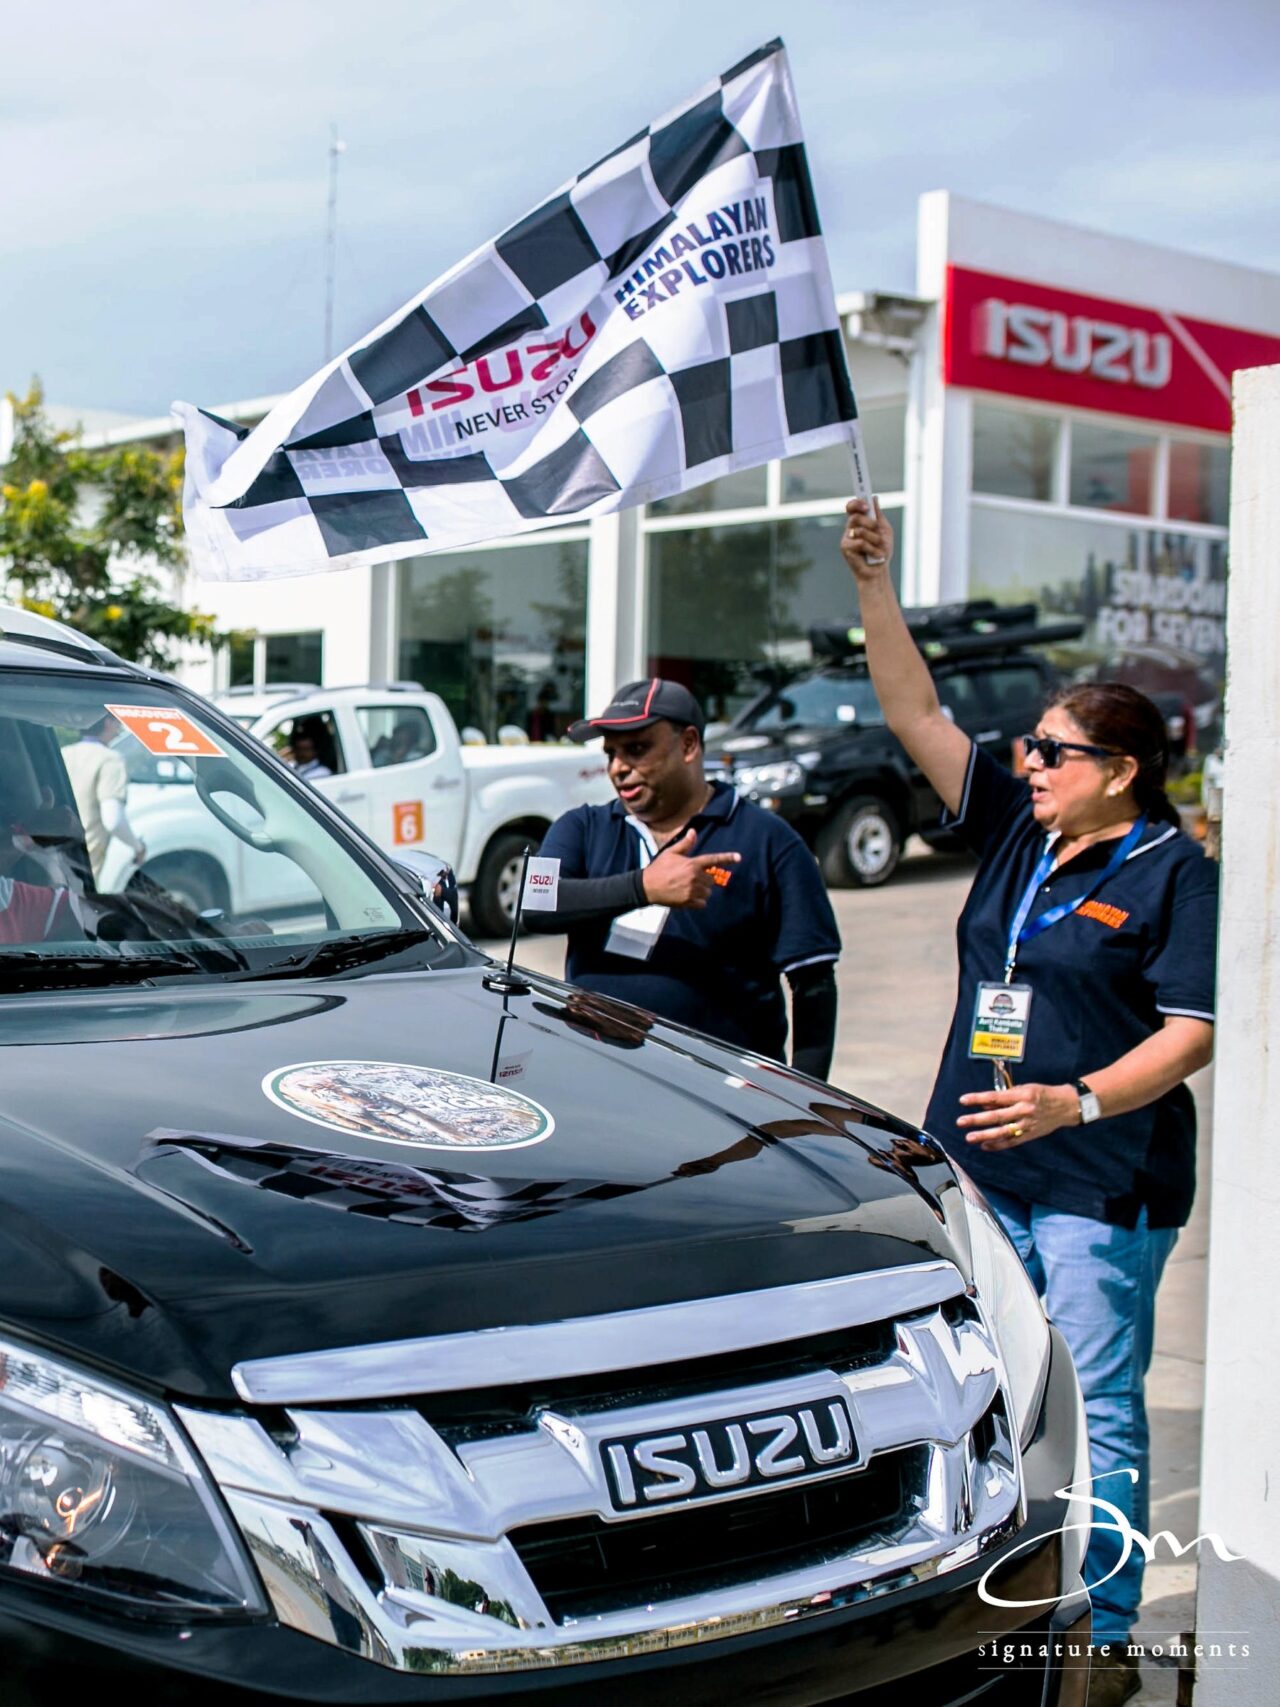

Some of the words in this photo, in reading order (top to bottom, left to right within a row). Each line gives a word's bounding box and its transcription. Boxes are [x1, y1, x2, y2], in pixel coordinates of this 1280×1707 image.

[613, 196, 768, 305] HIMALAYAN
[623, 234, 775, 321] EXPLORERS
[406, 311, 597, 418] ISUZU
[982, 298, 1173, 388] ISUZU
[455, 403, 529, 440] NEVER
[147, 721, 200, 751] 2
[400, 814, 418, 840] 6
[529, 874, 554, 885] ISUZU
[607, 1402, 854, 1506] ISUZU
